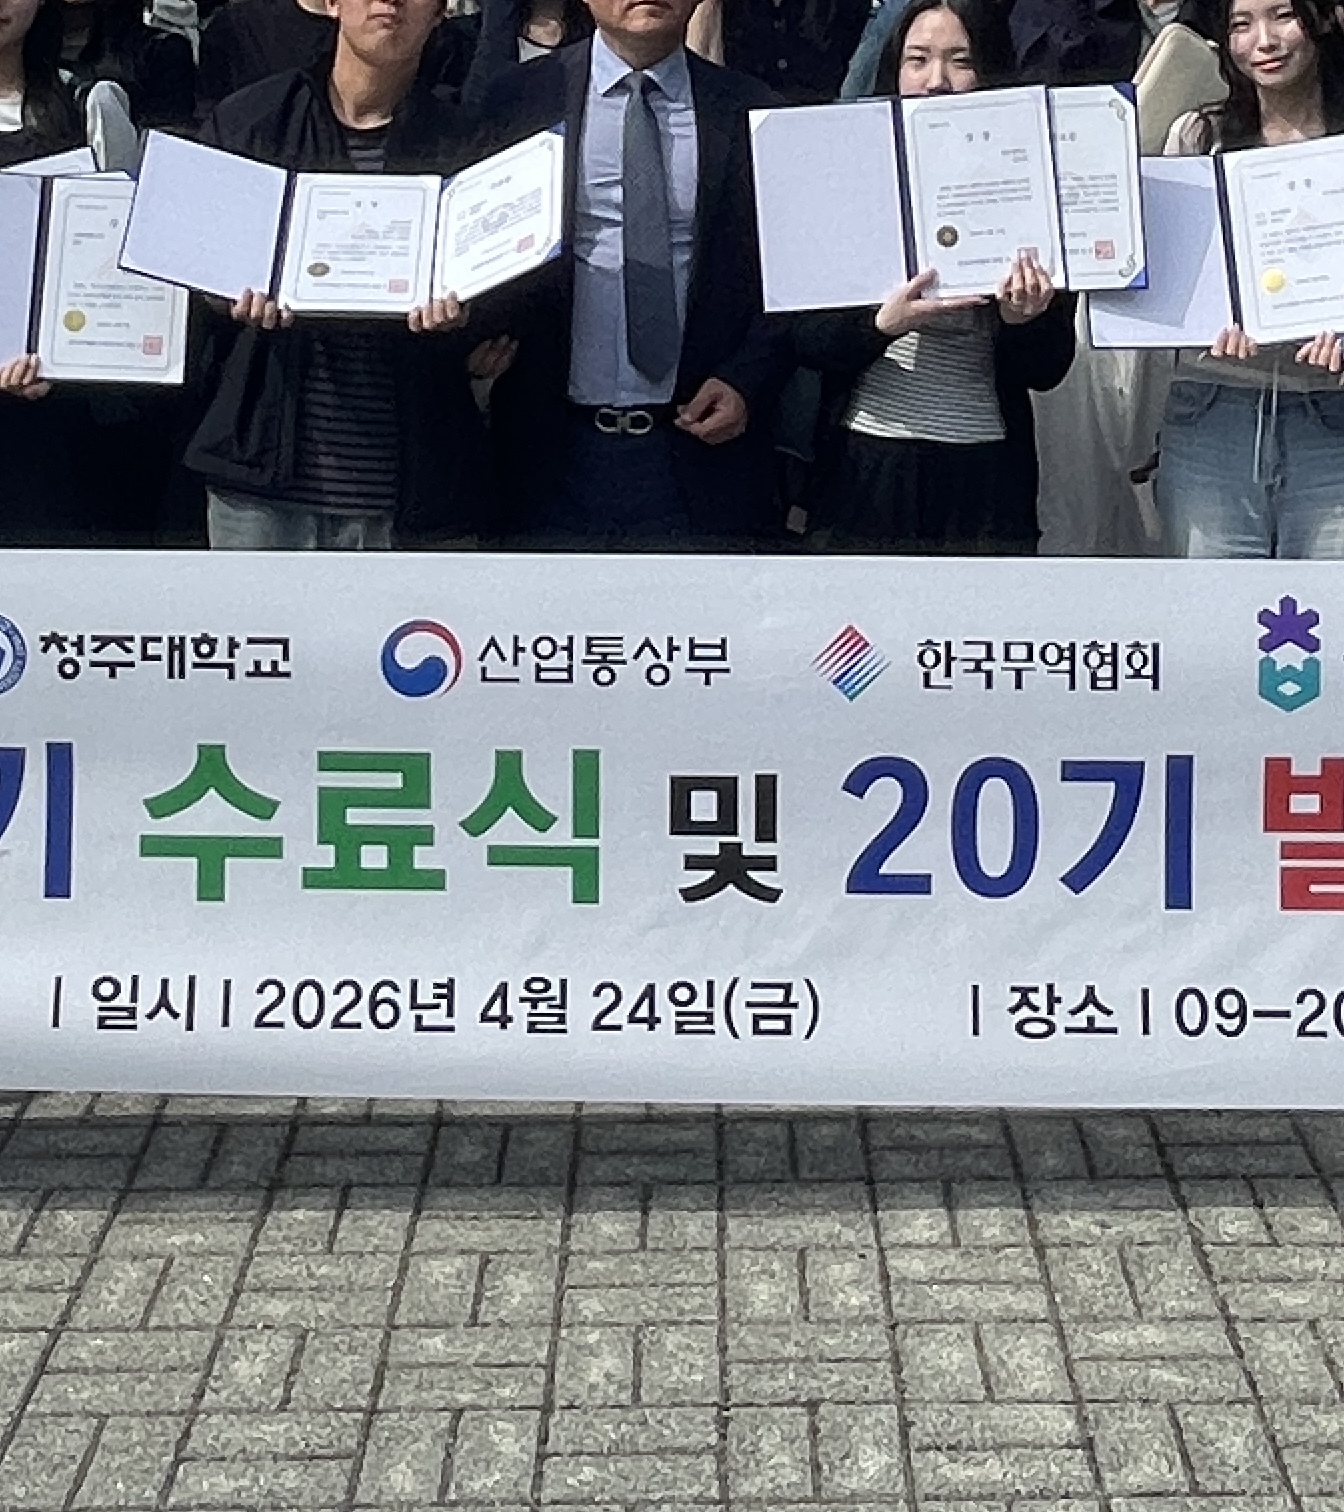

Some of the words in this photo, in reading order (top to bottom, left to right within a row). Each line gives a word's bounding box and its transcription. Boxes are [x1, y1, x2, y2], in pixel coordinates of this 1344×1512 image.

[38, 630, 293, 681] 청주대학교
[477, 633, 732, 688] 산업통상부
[915, 637, 1162, 693] 한국무역협회
[138, 742, 603, 905] 수료식
[668, 773, 785, 905] 및
[841, 754, 1196, 912] 20기
[91, 973, 197, 1033] 일시
[253, 976, 457, 1033] 2026년
[478, 975, 569, 1035] 4월
[591, 975, 821, 1041] 24일(금)
[1006, 981, 1119, 1041] 장소
